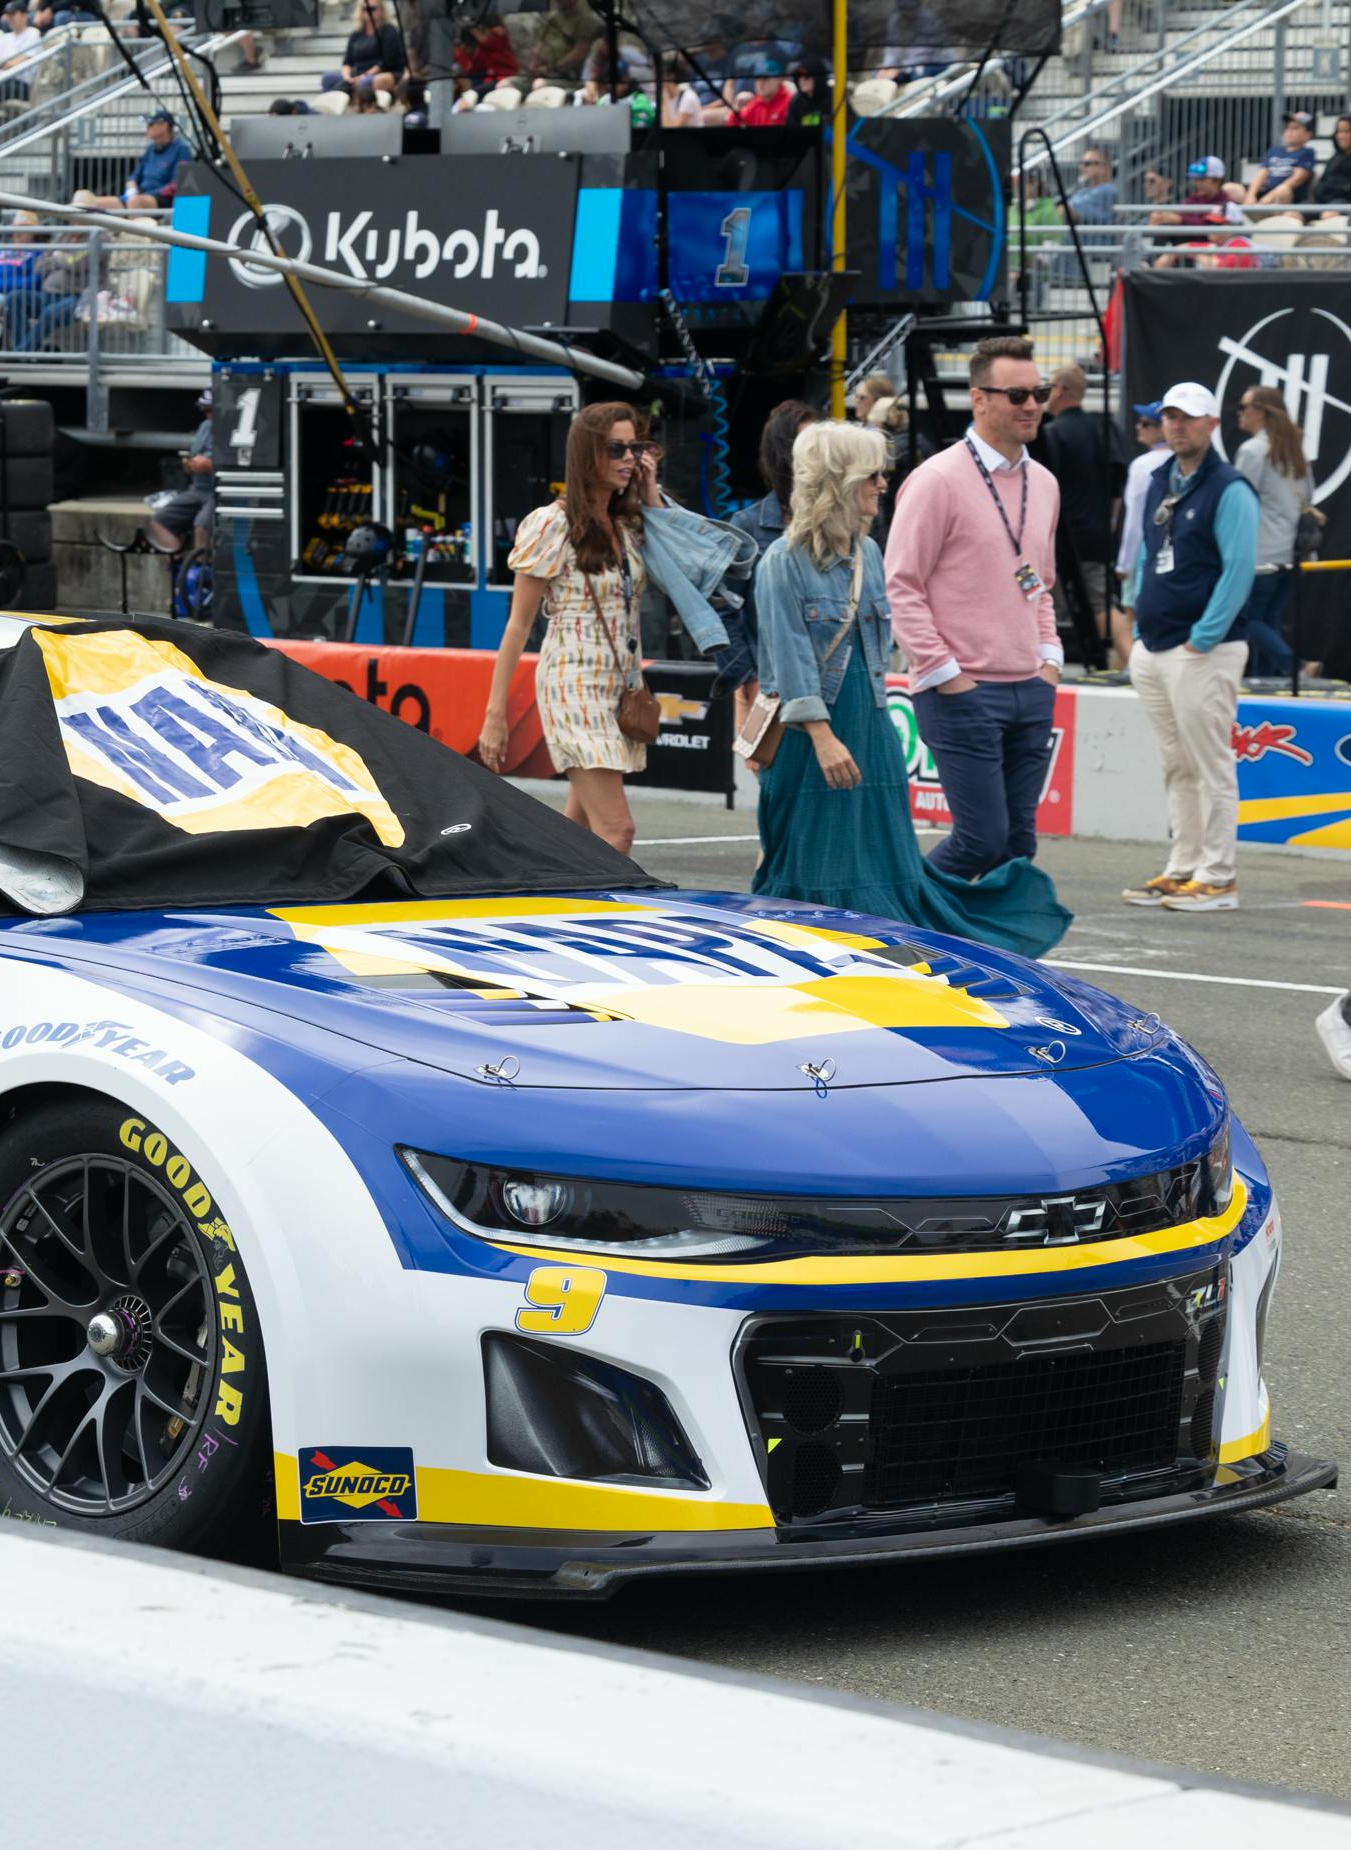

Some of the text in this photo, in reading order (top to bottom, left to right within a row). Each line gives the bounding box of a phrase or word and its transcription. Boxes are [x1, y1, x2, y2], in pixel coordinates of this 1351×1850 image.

[325, 209, 540, 279] Kubota
[714, 207, 752, 287] 1
[230, 388, 261, 447] 1
[916, 791, 950, 811] AUT
[515, 1265, 607, 1337] 9
[308, 1475, 407, 1496] SUNOCO
